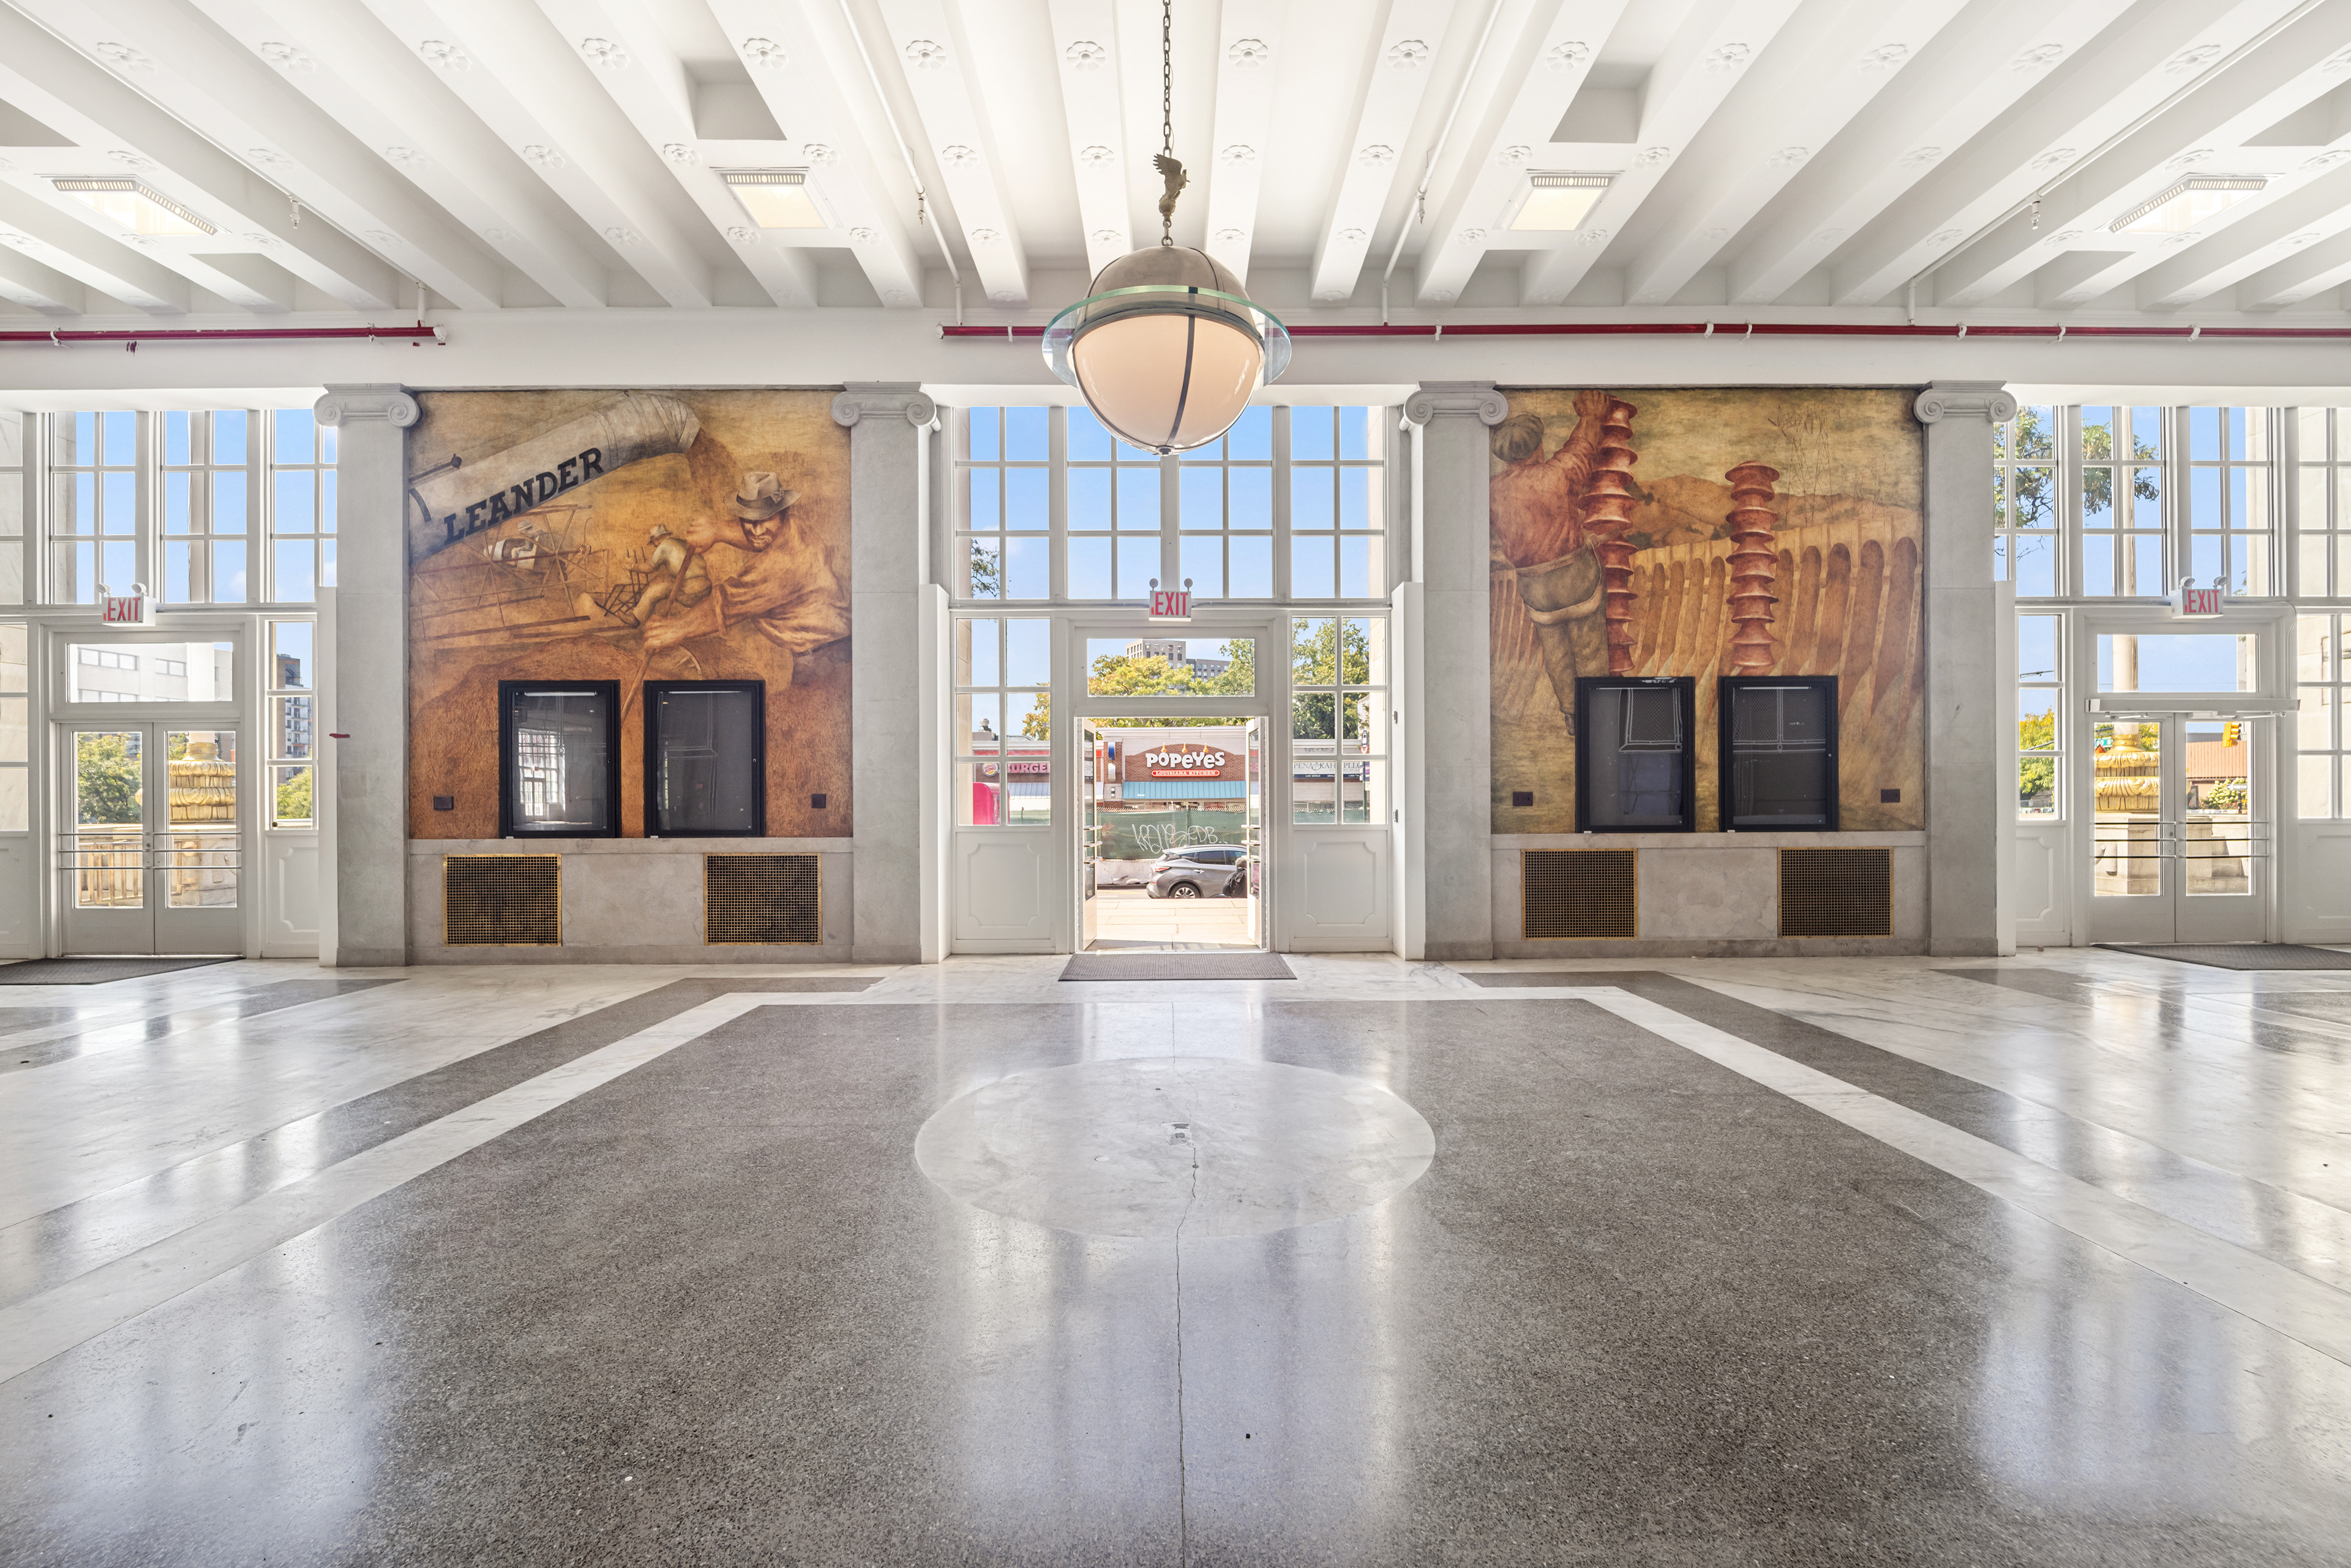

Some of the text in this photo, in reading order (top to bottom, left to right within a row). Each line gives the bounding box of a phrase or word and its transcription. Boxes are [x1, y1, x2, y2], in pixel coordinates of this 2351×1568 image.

[444, 448, 604, 546] LEANDER
[108, 598, 141, 621] EXIT
[1155, 592, 1188, 615] EXIT
[2188, 590, 2219, 613] EXIT
